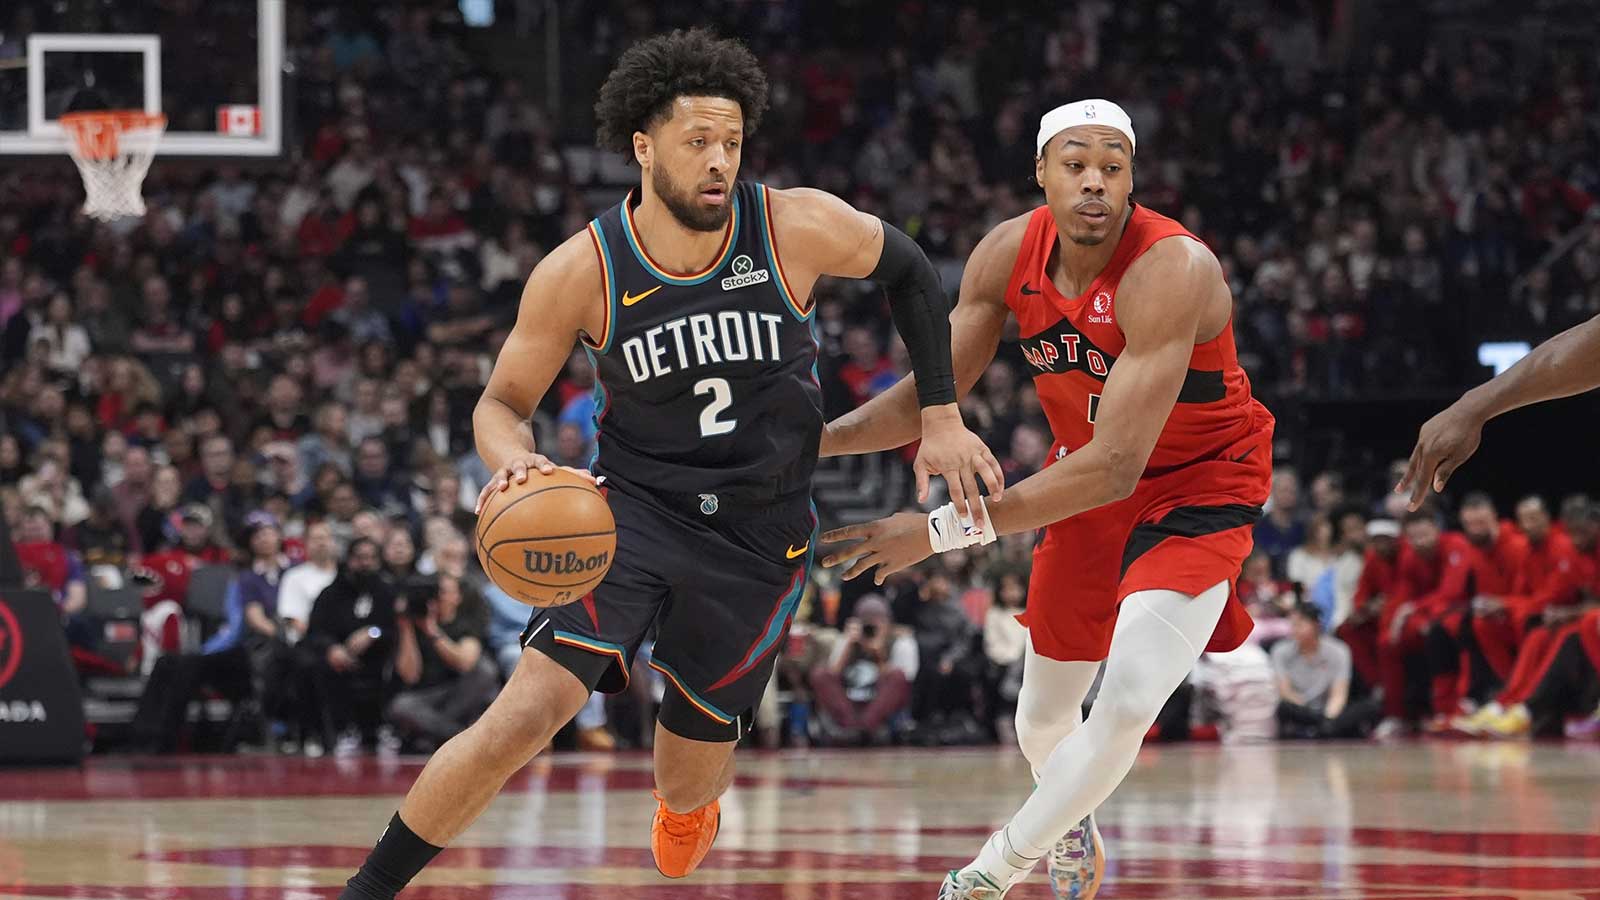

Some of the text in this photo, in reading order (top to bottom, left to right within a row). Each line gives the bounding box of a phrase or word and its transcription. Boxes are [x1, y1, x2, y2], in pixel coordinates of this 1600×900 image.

[723, 270, 768, 289] StockX
[1088, 315, 1113, 324] Sun Life
[622, 311, 783, 383] DETROIT
[693, 377, 738, 438] 2
[524, 549, 608, 574] Wilson
